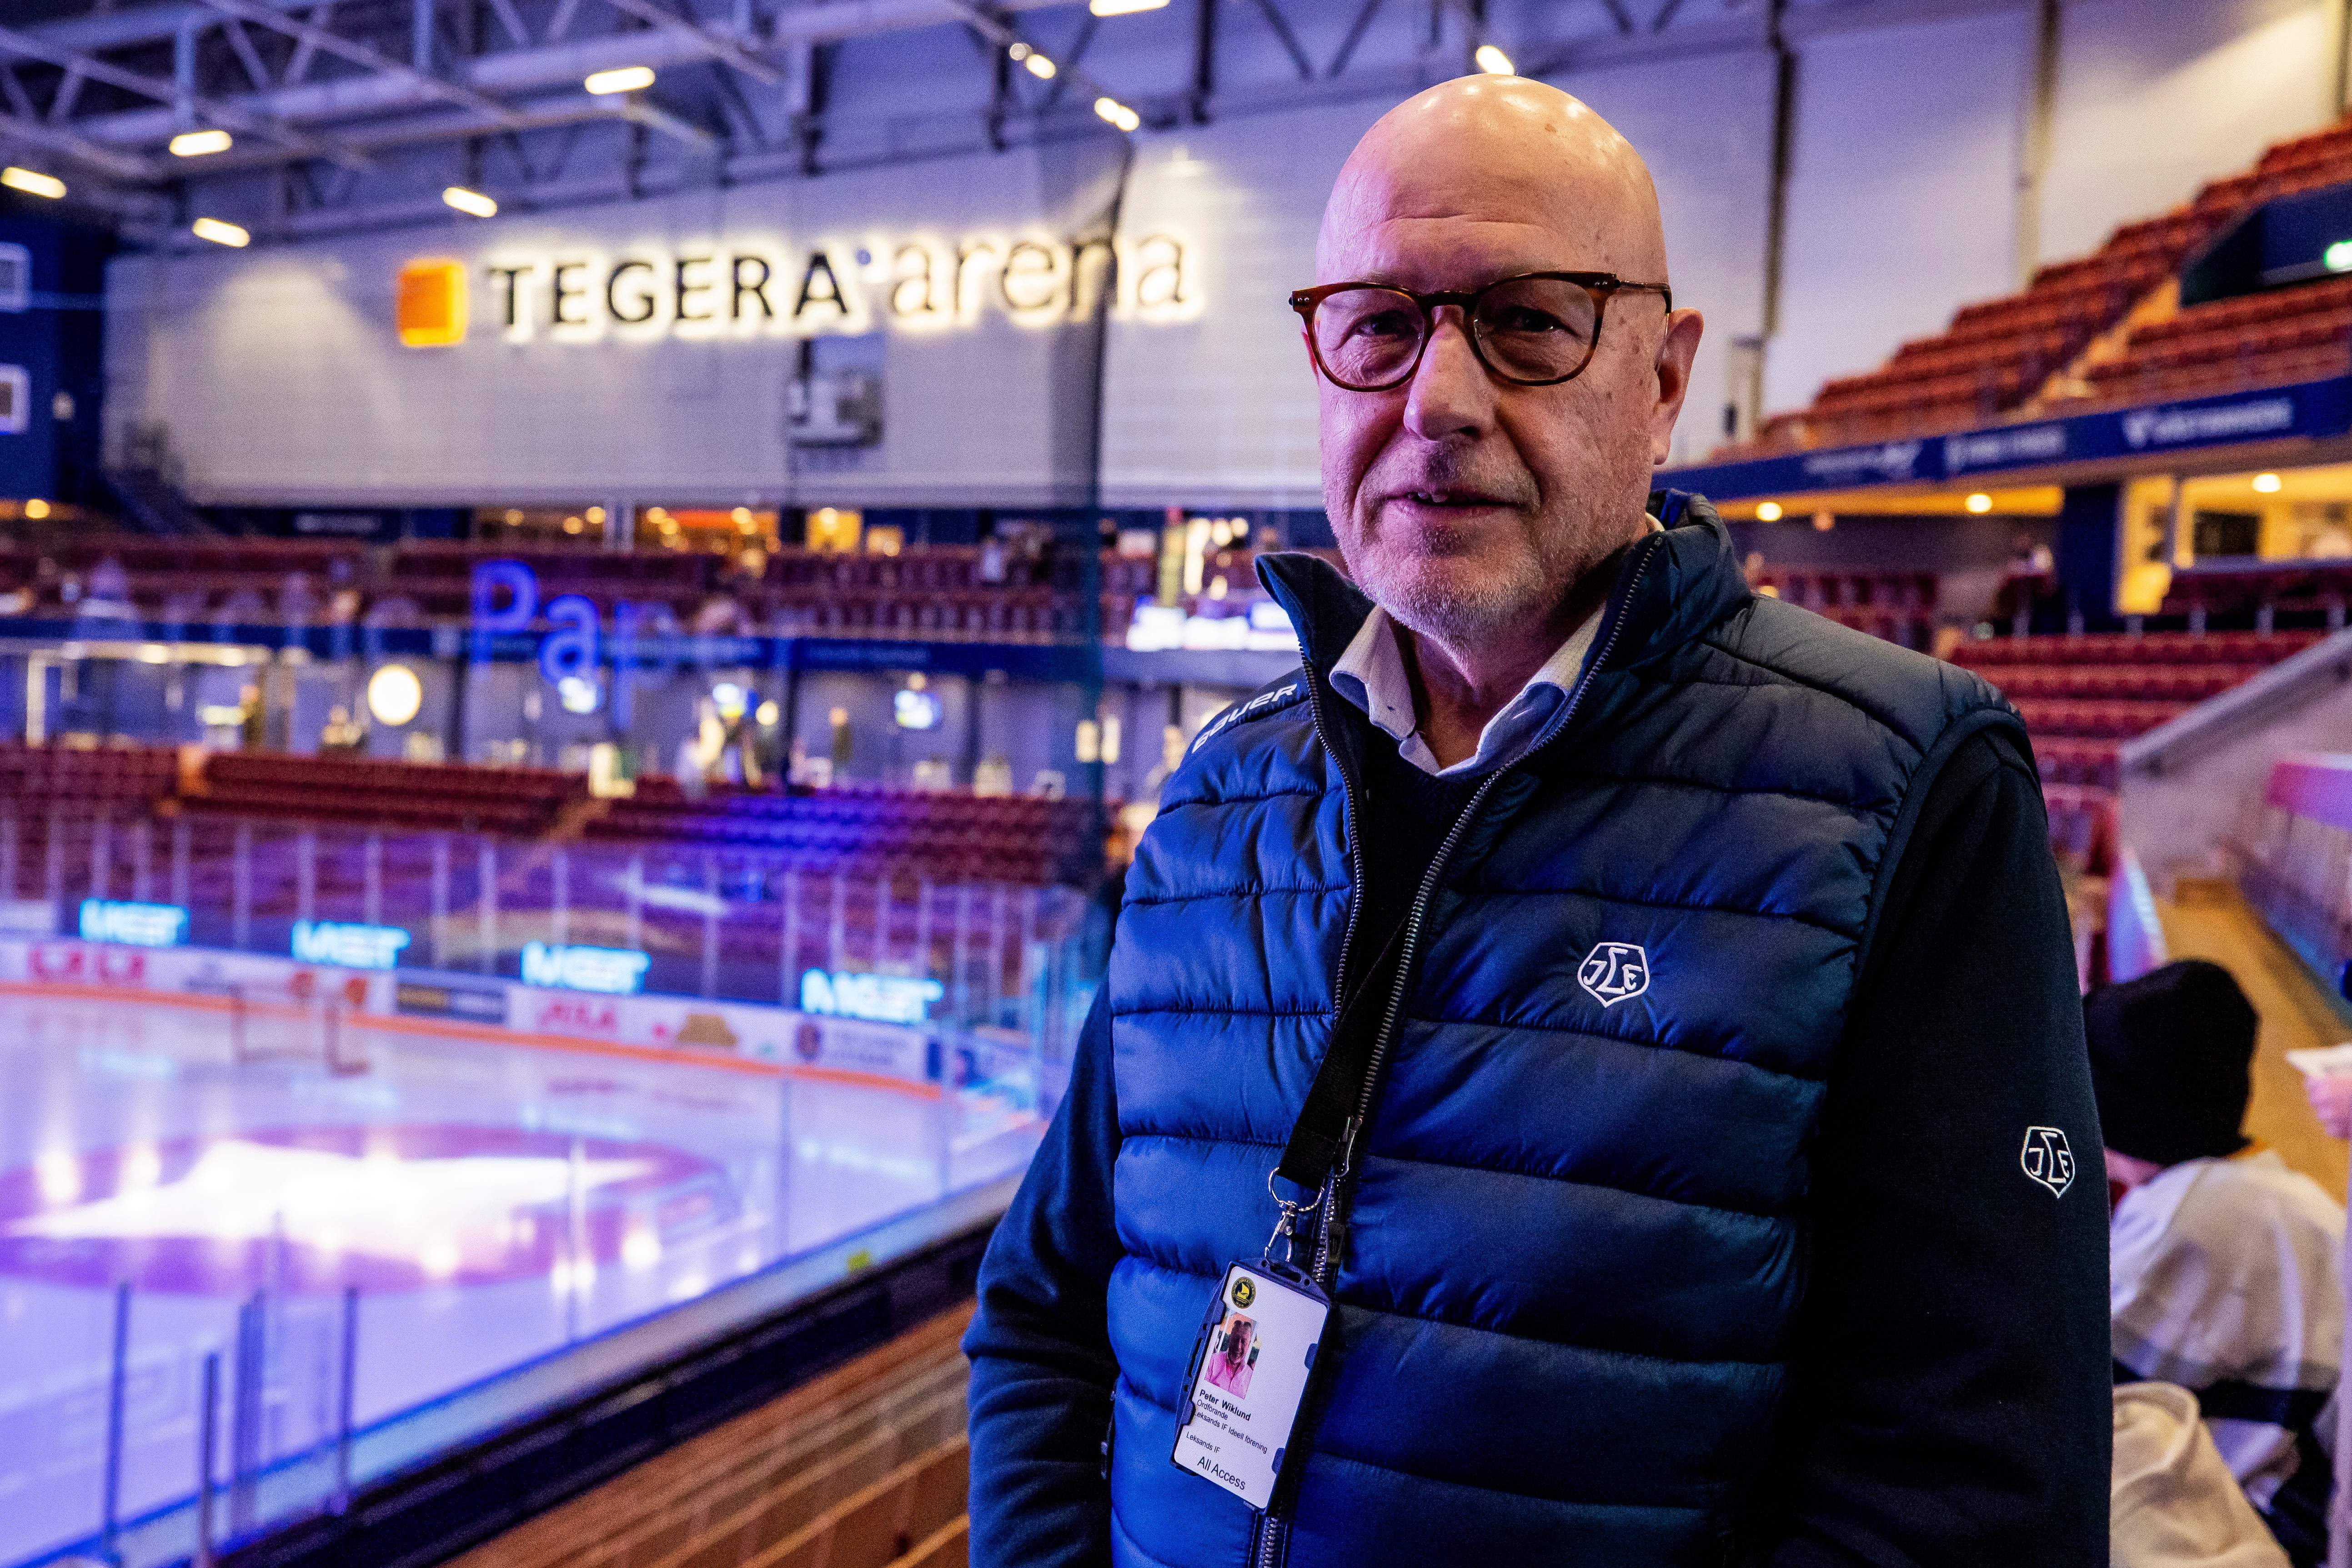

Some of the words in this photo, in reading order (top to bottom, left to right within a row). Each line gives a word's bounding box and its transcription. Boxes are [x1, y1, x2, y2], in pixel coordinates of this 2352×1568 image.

[487, 252, 850, 327] TEGERA
[889, 232, 1191, 316] arena
[1199, 1389, 1219, 1405] Peter
[1221, 1399, 1251, 1421] Wiklund
[1186, 1431, 1213, 1450] Leksands
[1228, 1427, 1244, 1440] Ideell
[1244, 1435, 1268, 1454] förening
[1197, 1456, 1211, 1471] All
[1210, 1463, 1246, 1490] Access
